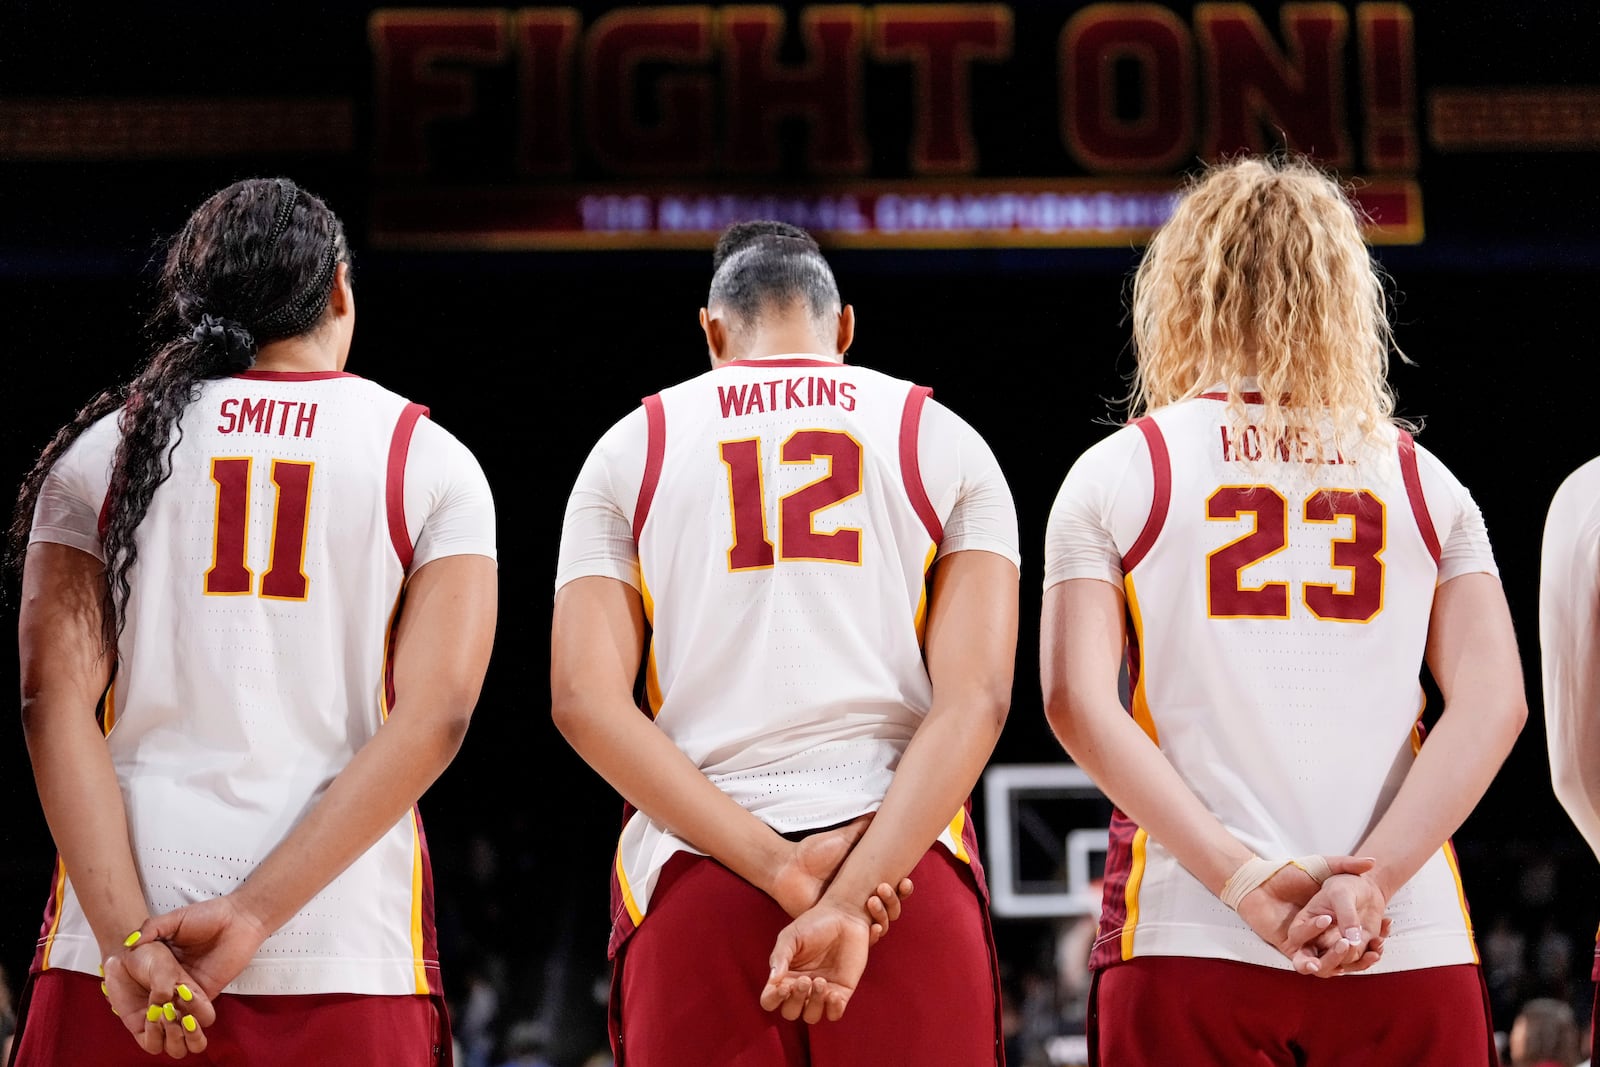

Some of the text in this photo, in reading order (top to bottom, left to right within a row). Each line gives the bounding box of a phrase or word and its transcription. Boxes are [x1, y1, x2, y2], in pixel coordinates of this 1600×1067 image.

[368, 2, 1419, 175] FIGHT ON!
[217, 398, 318, 438] SMITH
[717, 376, 857, 418] WATKINS
[203, 456, 315, 601] 11
[718, 428, 864, 573] 12
[1205, 484, 1386, 624] 23
